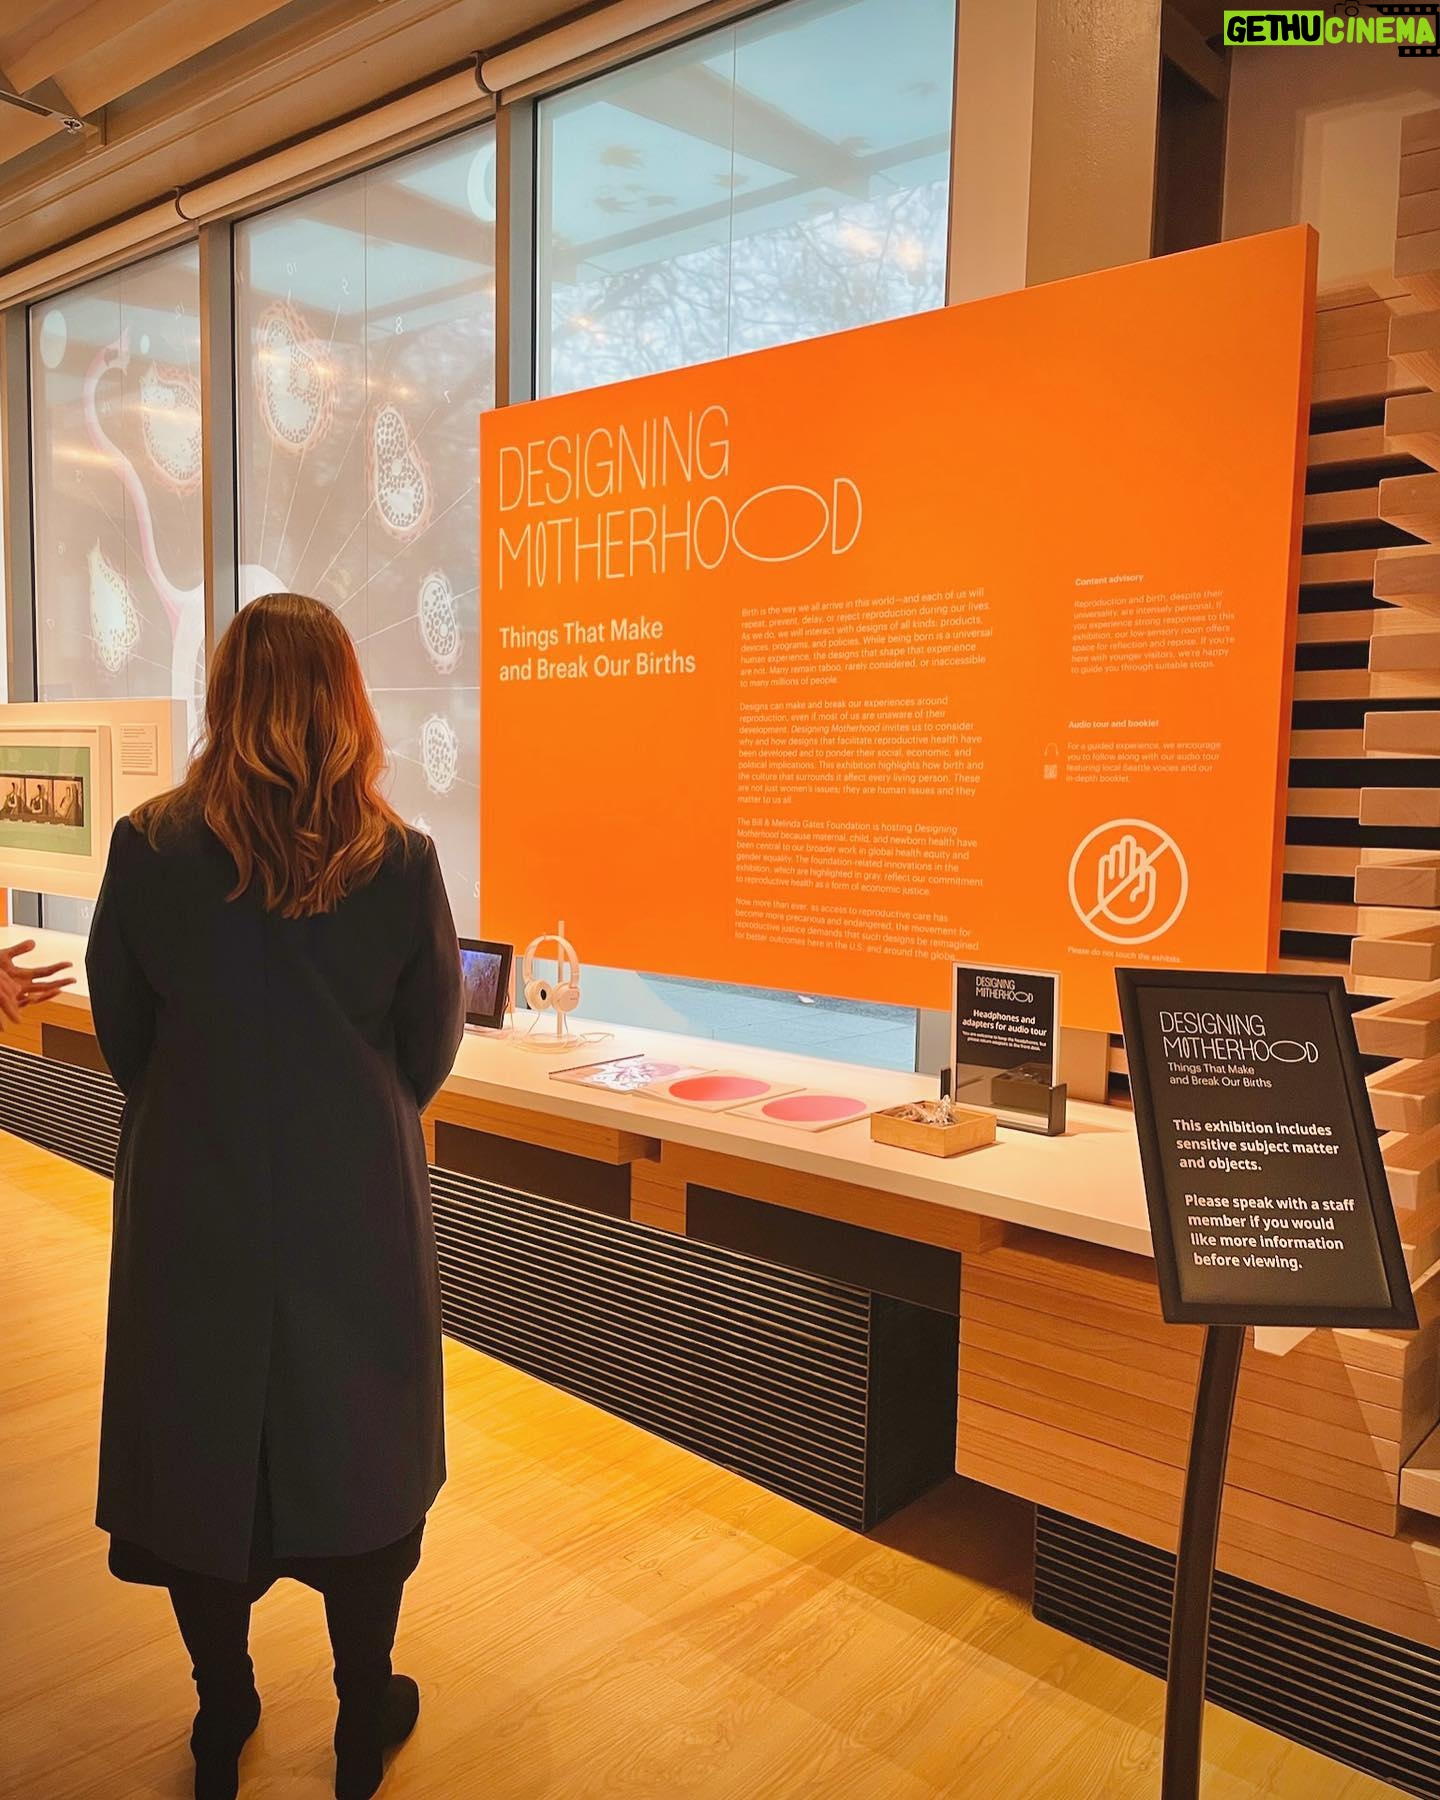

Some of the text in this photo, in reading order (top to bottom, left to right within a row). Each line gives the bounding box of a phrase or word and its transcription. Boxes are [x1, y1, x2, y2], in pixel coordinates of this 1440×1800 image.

[499, 404, 729, 511] DESIGNING
[498, 477, 862, 590] MOTHERHOOD
[1074, 574, 1144, 586] Content advisory
[499, 617, 663, 650] Things That Make
[499, 651, 696, 681] and Break Our Births
[1068, 720, 1092, 728] Audio
[1110, 719, 1126, 727] and
[1127, 719, 1159, 727] booklet
[973, 1009, 1035, 1024] Headphones and
[1159, 1011, 1265, 1035] DESIGNING
[962, 1018, 1046, 1035] adapters for audio tour
[1163, 1037, 1318, 1062] MOTHERHOOD
[1167, 1062, 1254, 1077] Things That Make
[1169, 1075, 1272, 1087] and Break Our Births
[1172, 1119, 1332, 1135] This exhibition includes
[1176, 1138, 1338, 1154] sensitive subject matter
[1179, 1156, 1261, 1172] and objects.
[1185, 1194, 1354, 1210] Please speak with a staff
[1188, 1215, 1334, 1231] member if you would
[1190, 1232, 1343, 1249] like more information
[1193, 1252, 1302, 1271] before viewing.
